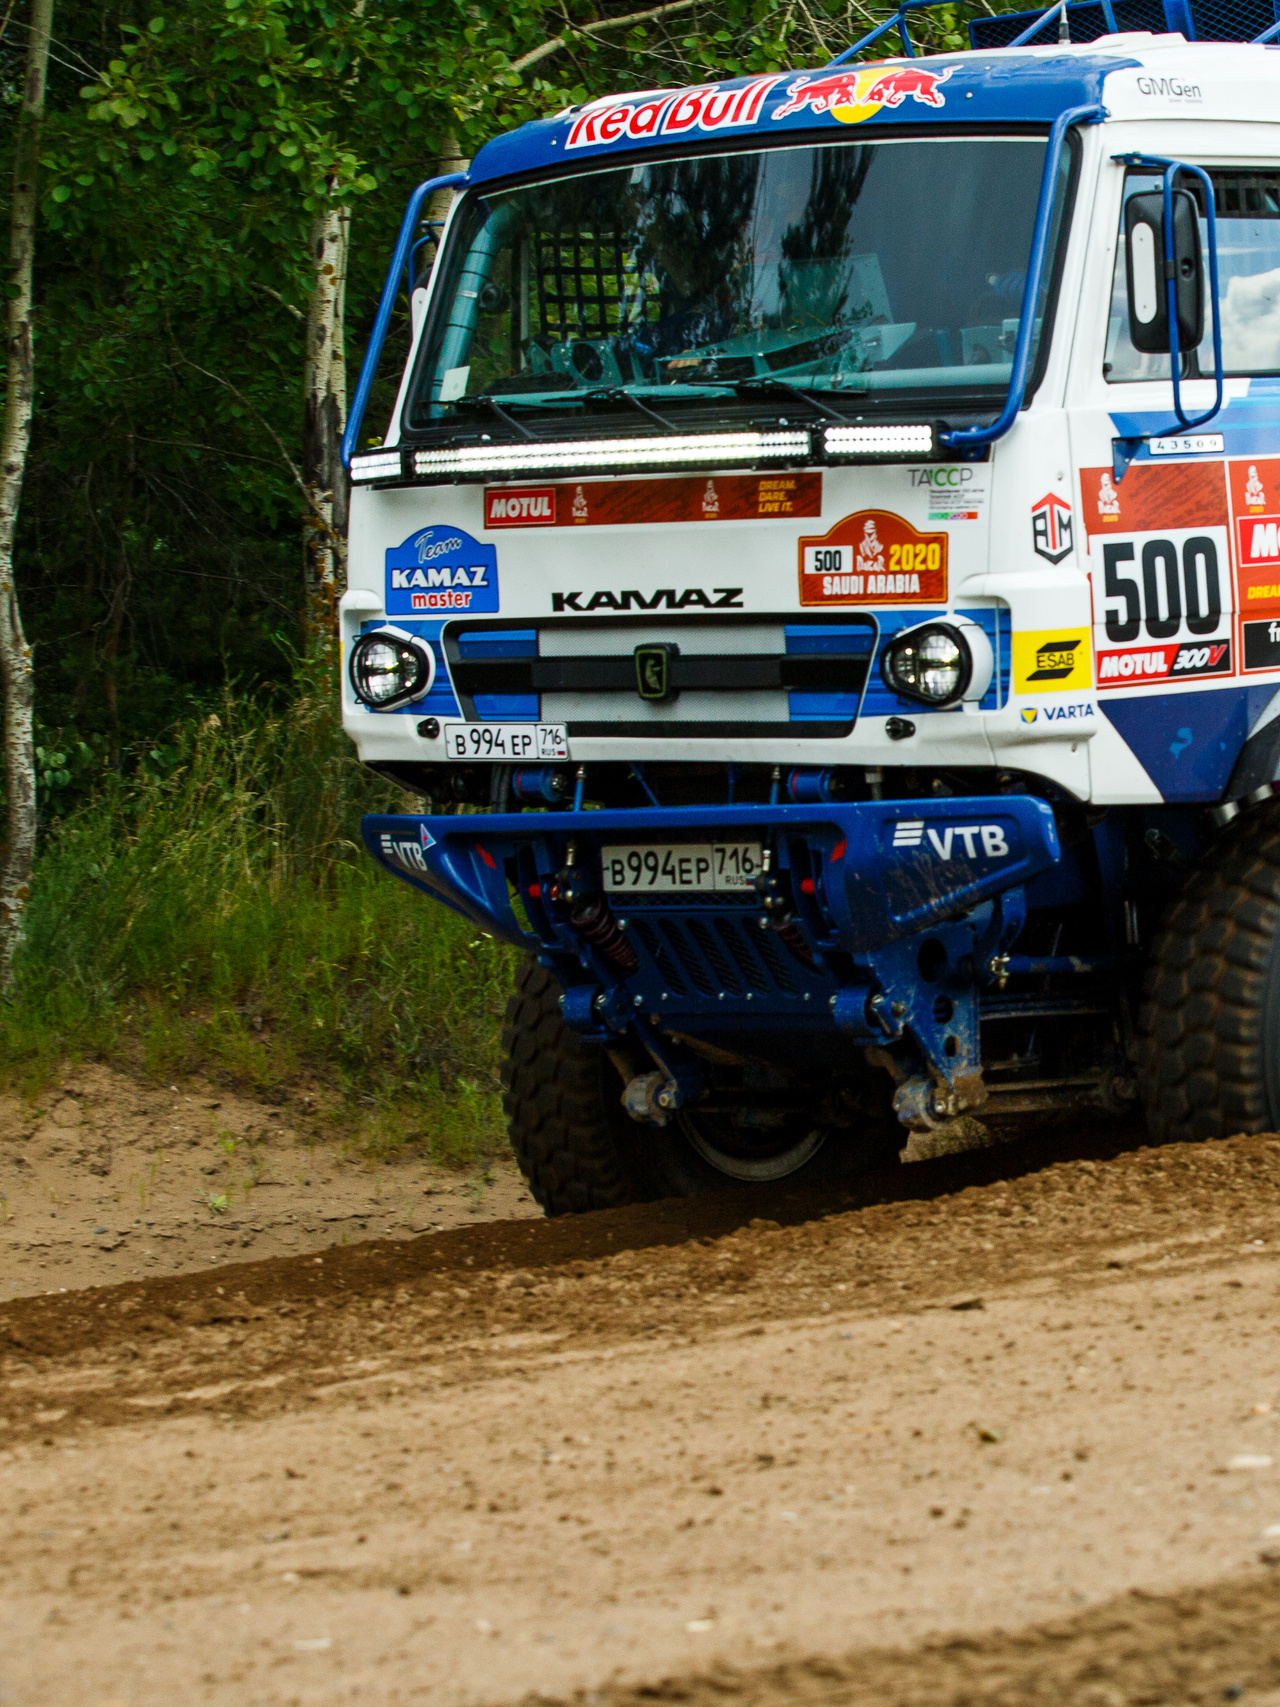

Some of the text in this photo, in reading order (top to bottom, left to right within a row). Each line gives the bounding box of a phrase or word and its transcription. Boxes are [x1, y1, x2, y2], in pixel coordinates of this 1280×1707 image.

[1136, 77, 1202, 98] GMGen
[567, 77, 778, 147] Red Bull
[490, 496, 552, 519] MOTUL
[415, 531, 462, 564] Team
[889, 543, 941, 571] 2020
[814, 550, 842, 572] 500
[391, 566, 488, 589] KAMAZ
[822, 574, 920, 596] SAUDI ARABIA
[411, 590, 472, 609] master
[551, 587, 744, 612] KAMAZ
[1103, 536, 1222, 643] 500
[1037, 653, 1075, 669] ESAB
[1100, 644, 1228, 678] MOTUL 300V
[1043, 703, 1095, 721] VARTA
[540, 728, 562, 745] 716
[541, 748, 557, 756] RUS
[926, 824, 1010, 861] VTB
[392, 841, 428, 872] VTB
[714, 847, 755, 875] 716
[724, 875, 745, 886] RUS
